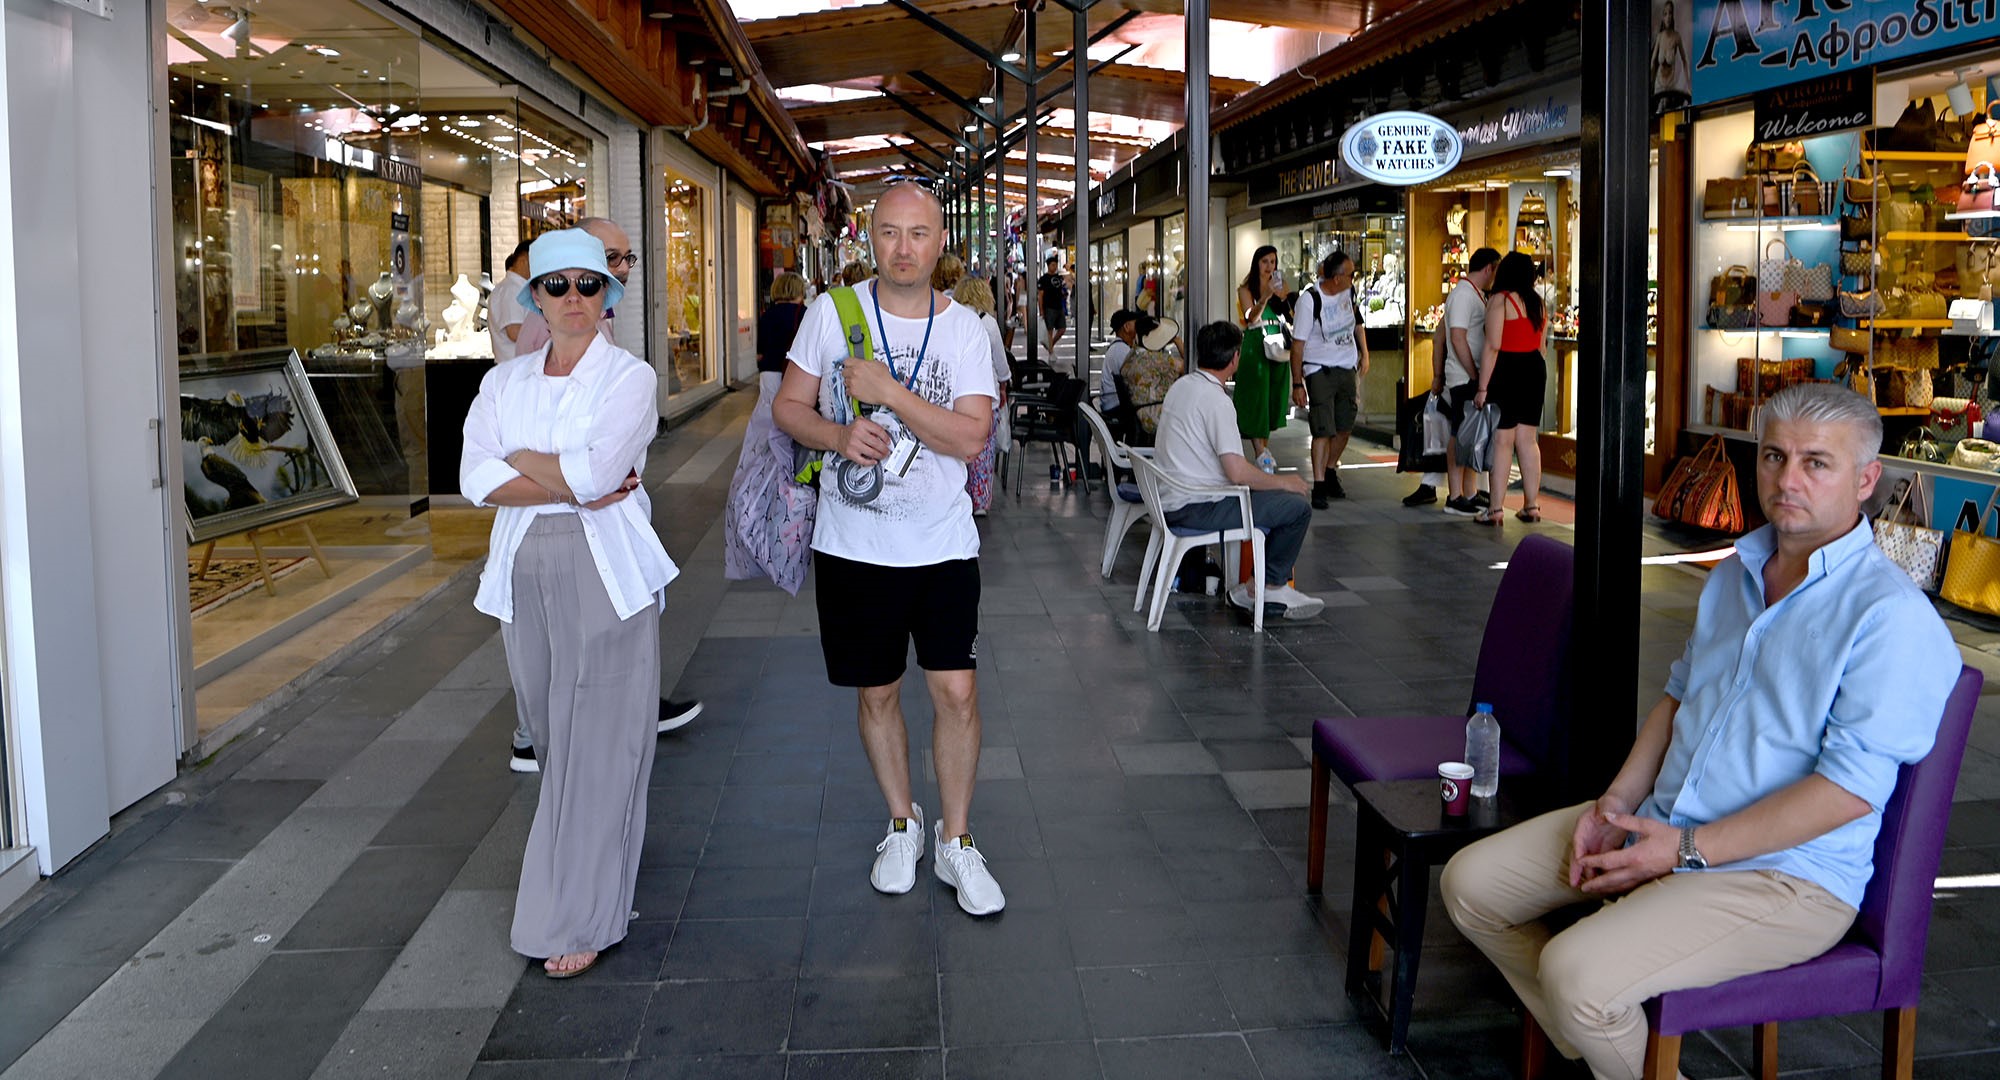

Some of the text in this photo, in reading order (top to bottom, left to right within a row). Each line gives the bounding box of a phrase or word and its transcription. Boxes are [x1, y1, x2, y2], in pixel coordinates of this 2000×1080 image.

[1378, 125, 1432, 137] GENUINE
[1760, 111, 1866, 139] Welcome
[1383, 140, 1428, 155] FAKE
[380, 158, 420, 186] KERVAN
[1376, 158, 1435, 170] WATCHES
[1279, 160, 1339, 196] THE JEWEL
